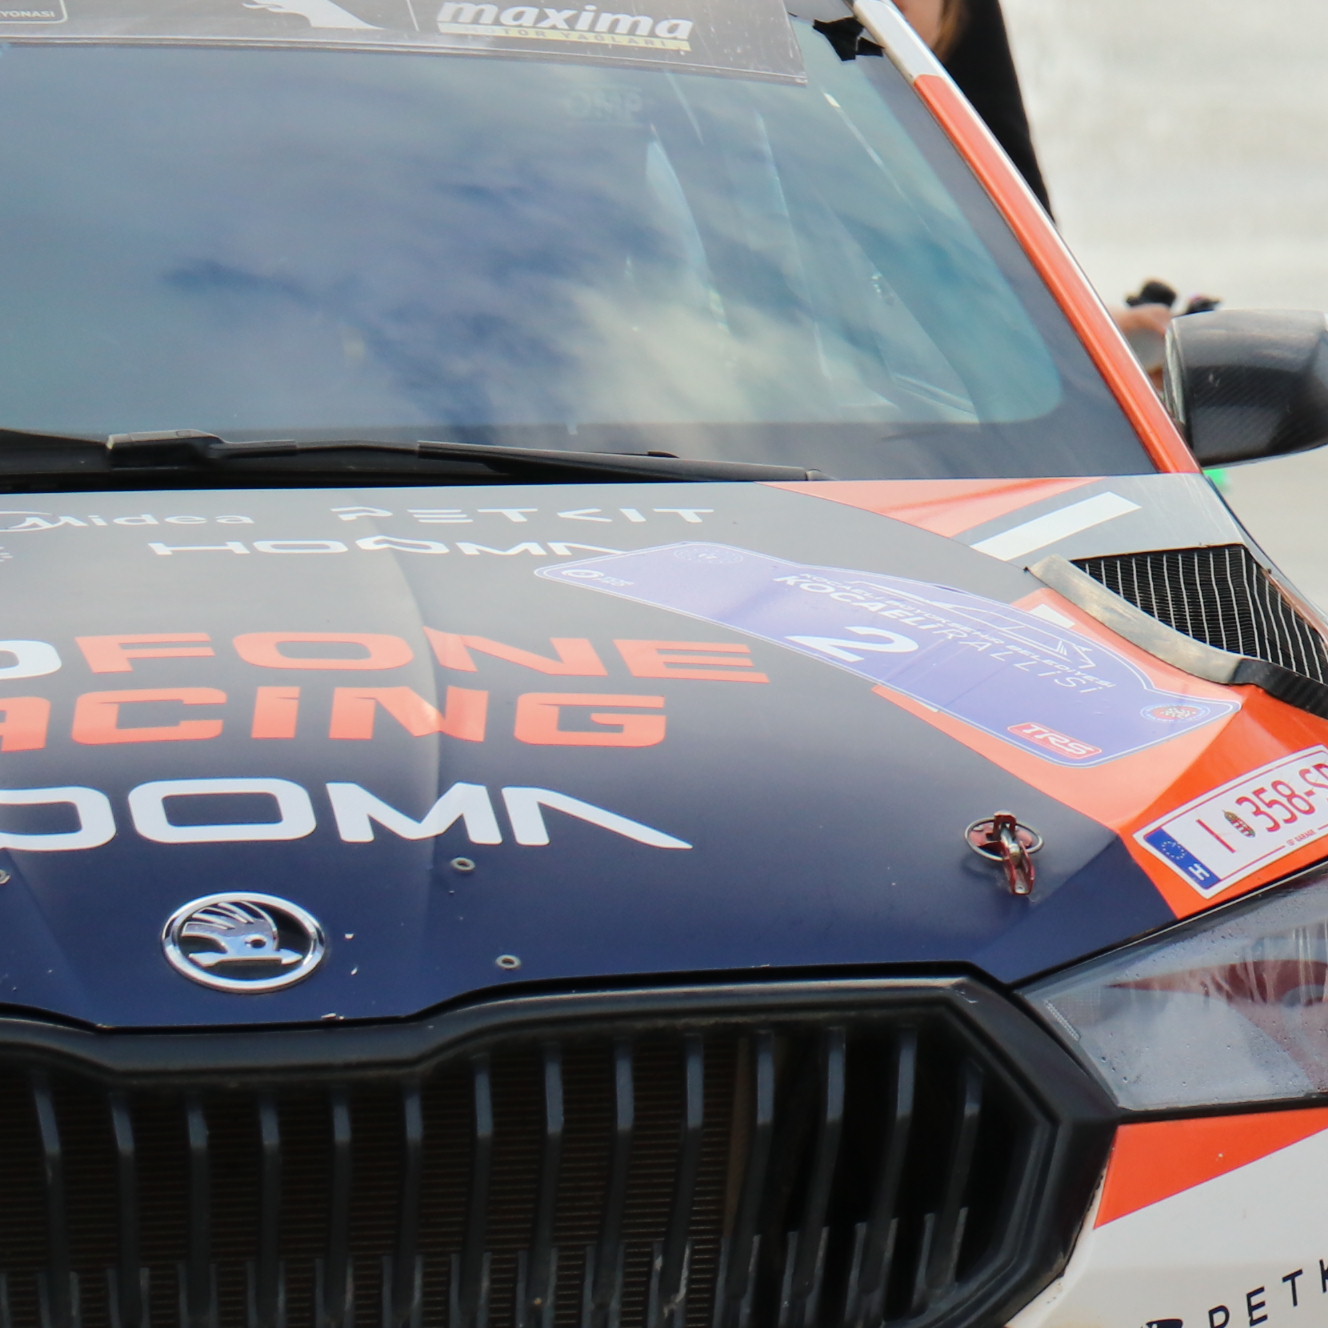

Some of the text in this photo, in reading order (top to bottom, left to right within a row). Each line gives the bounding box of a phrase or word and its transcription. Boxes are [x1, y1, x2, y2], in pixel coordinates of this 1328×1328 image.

[436, 2, 694, 41] maxima
[5, 505, 715, 530] Midea PETKIT
[784, 625, 920, 664] 2
[1022, 723, 1096, 756] TRS
